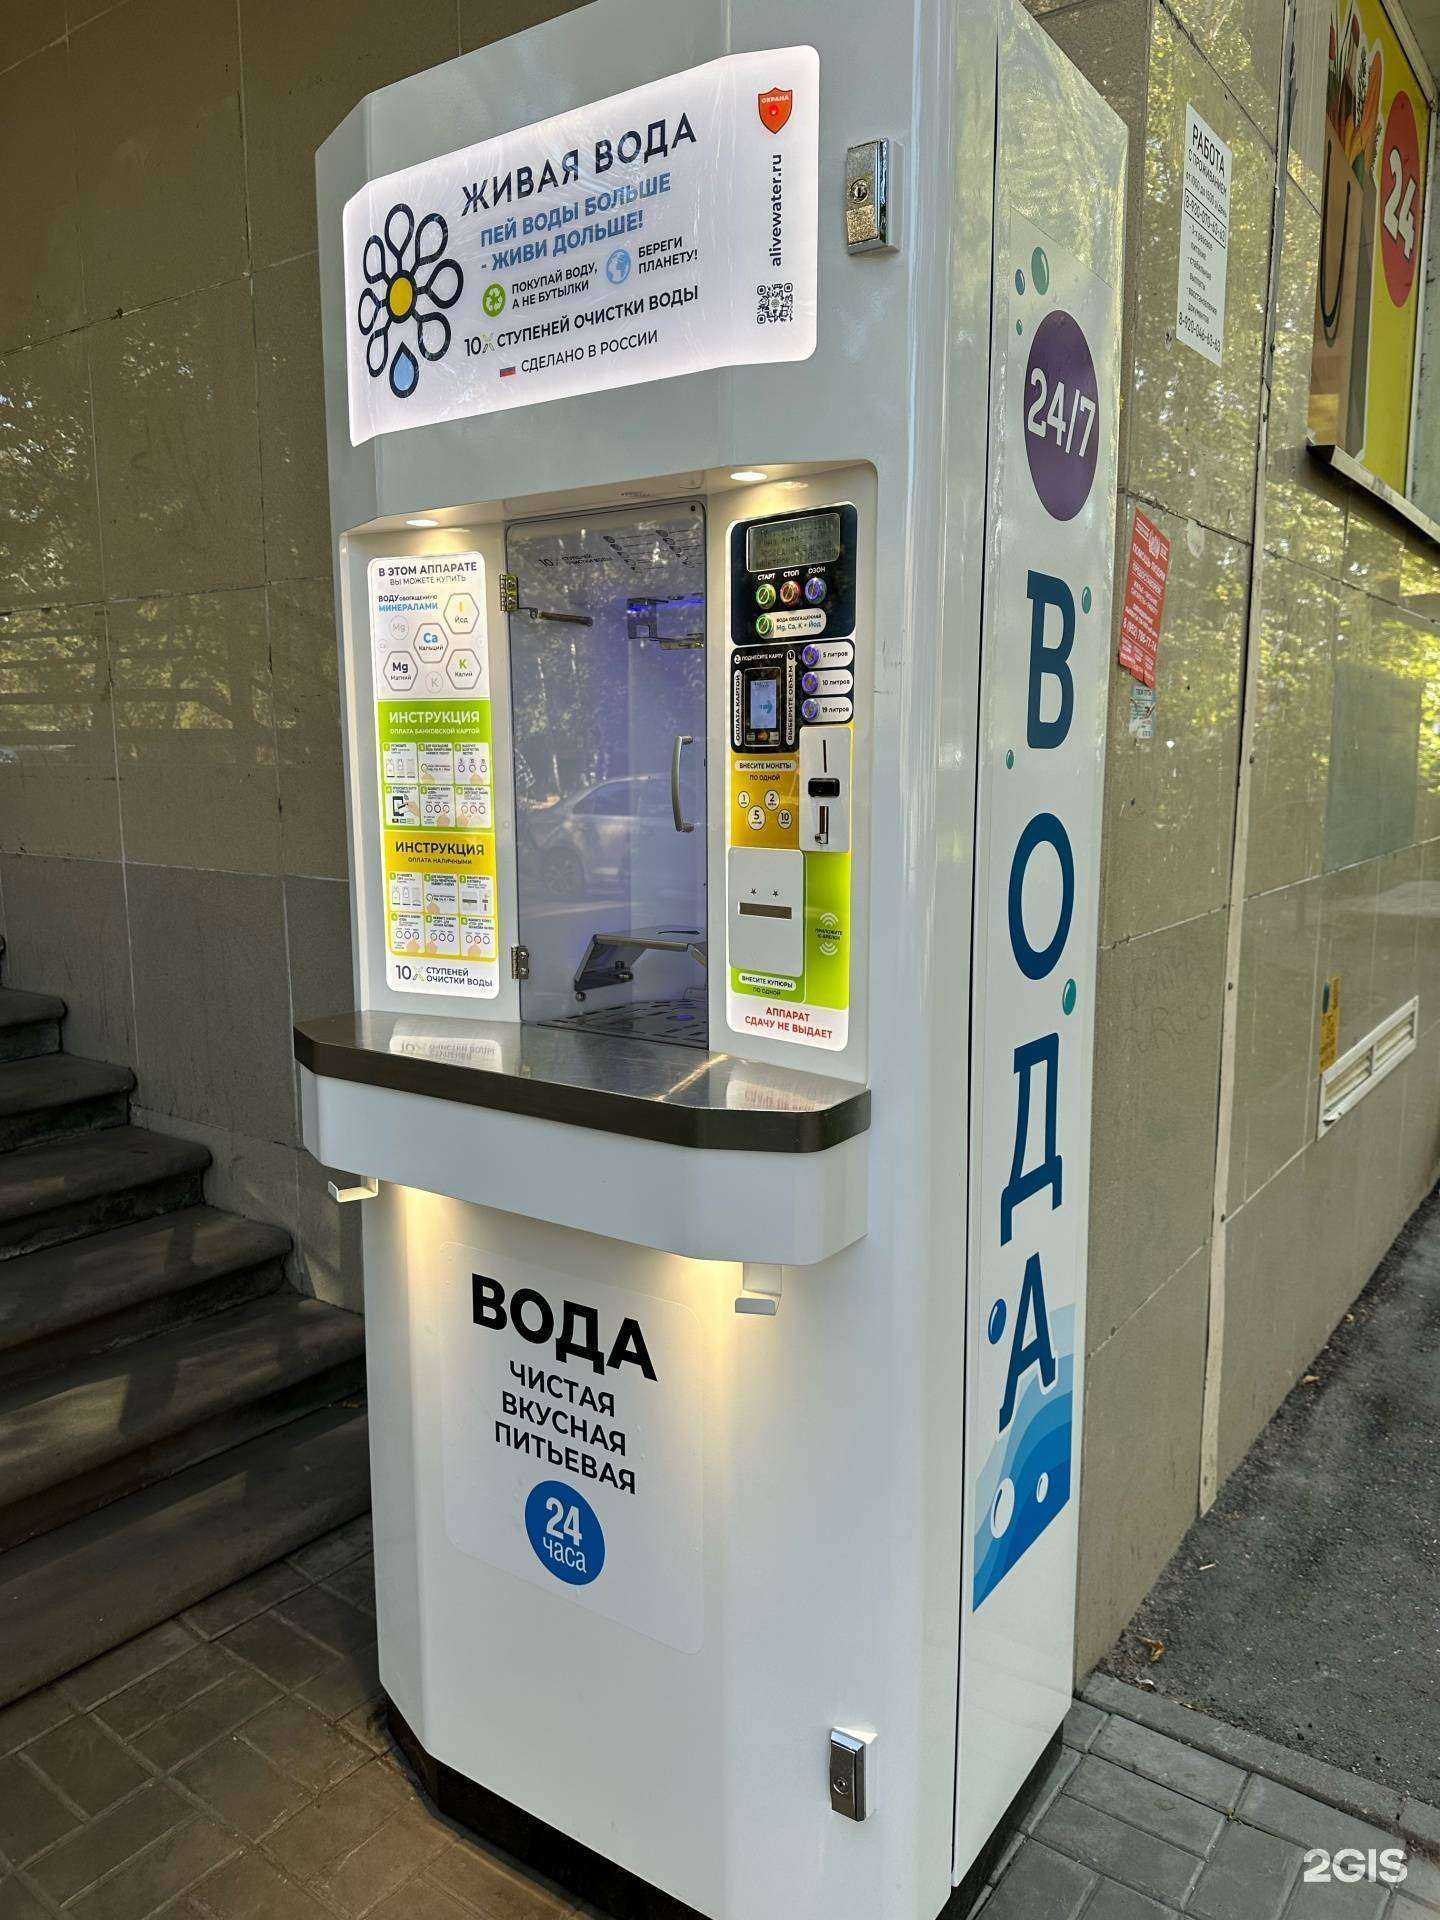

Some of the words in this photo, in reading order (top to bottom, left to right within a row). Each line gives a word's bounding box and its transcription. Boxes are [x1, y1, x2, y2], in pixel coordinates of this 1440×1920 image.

[761, 94, 790, 104] ОХРАНА
[1192, 123, 1225, 178] РАБОТА
[461, 149, 579, 217] ЖИВАЯ
[595, 112, 697, 174] ВОДА
[1188, 148, 1193, 162] С
[1193, 152, 1227, 198] ПРОЖИВАНИЕМ
[480, 217, 517, 247] ПЕЙ
[522, 202, 579, 235] ВОДЫ
[585, 172, 671, 216] БОЛЬШЕ
[769, 153, 783, 267] alivewater.ru
[1384, 147, 1416, 260] 24
[491, 239, 548, 271] ЖИВИ
[552, 209, 643, 257] ДОЛЬШЕ!
[638, 236, 683, 259] БЕРЕГИ
[638, 249, 698, 275] ПЛАНЕТУ!
[511, 270, 563, 294] ПОКУПАЙ
[565, 262, 598, 284] ВОДУ,
[511, 299, 520, 310] А
[522, 296, 536, 307] НЕ
[538, 280, 589, 304] БУТЫЛКИ
[496, 316, 570, 348] СТУПЕНЕЙ
[574, 298, 645, 330] ОЧИСТКИ
[649, 285, 699, 311] ВОДЫ
[521, 347, 585, 373] СДЕЛАНО
[588, 344, 597, 357] В
[600, 329, 658, 355] РОССИИ
[1027, 367, 1096, 458] 24/7
[378, 567, 386, 577] В
[388, 565, 417, 577] ЭТОМ
[420, 561, 478, 575] АППАРАТЕ
[757, 573, 776, 581] СТАРТ
[783, 569, 800, 578] СТОП
[807, 566, 826, 575] ОЗОН
[390, 578, 402, 586] ВЫ
[403, 576, 435, 585] МОЖЕТЕ
[436, 574, 467, 583] КУПИТЬ
[378, 594, 399, 603] ВОДУ
[378, 602, 438, 612] МИНЕРАЛАМИ
[454, 616, 469, 624] Йод
[423, 633, 439, 643] Ca
[827, 651, 848, 659] литров
[392, 662, 409, 674] Mg
[829, 679, 850, 687] литров
[389, 710, 480, 725] ИНСТРУКЦИЯ
[829, 706, 850, 714] литров
[390, 727, 413, 735] ОПЛАТА
[414, 727, 456, 735] БАНКОВСКОЙ
[456, 727, 480, 735] КАРТОЙ
[759, 773, 781, 781] ОДНОЙ
[769, 793, 775, 802] 2
[753, 810, 760, 820] 5
[780, 812, 790, 821] 10
[395, 841, 485, 857] ИНСТРУКЦИЯ
[395, 964, 412, 980] 10
[426, 966, 469, 977] СТУПЕНЕЙ
[426, 975, 465, 985] ОЧИСТКИ
[467, 978, 493, 988] ВОДЫ
[741, 975, 767, 985] ВНЕСИТЕ
[767, 978, 793, 989] КУПЮРЫ
[752, 986, 761, 994] ПО
[761, 988, 781, 996] ОДНОЙ
[1000, 569, 1076, 1434] ВОДА
[765, 1006, 810, 1022] АППАРАТ
[744, 1015, 776, 1030] СДАЧУ
[777, 1020, 790, 1032] НЕ
[792, 1024, 833, 1039] ВЫДАЕТ
[471, 1272, 658, 1382] ВОДА
[509, 1359, 616, 1418] ЧИСТАЯ
[502, 1389, 627, 1457] ВКУСНАЯ
[494, 1420, 637, 1496] ПИТЬЕВАЯ
[545, 1496, 583, 1546] 24
[543, 1537, 588, 1574] часа
